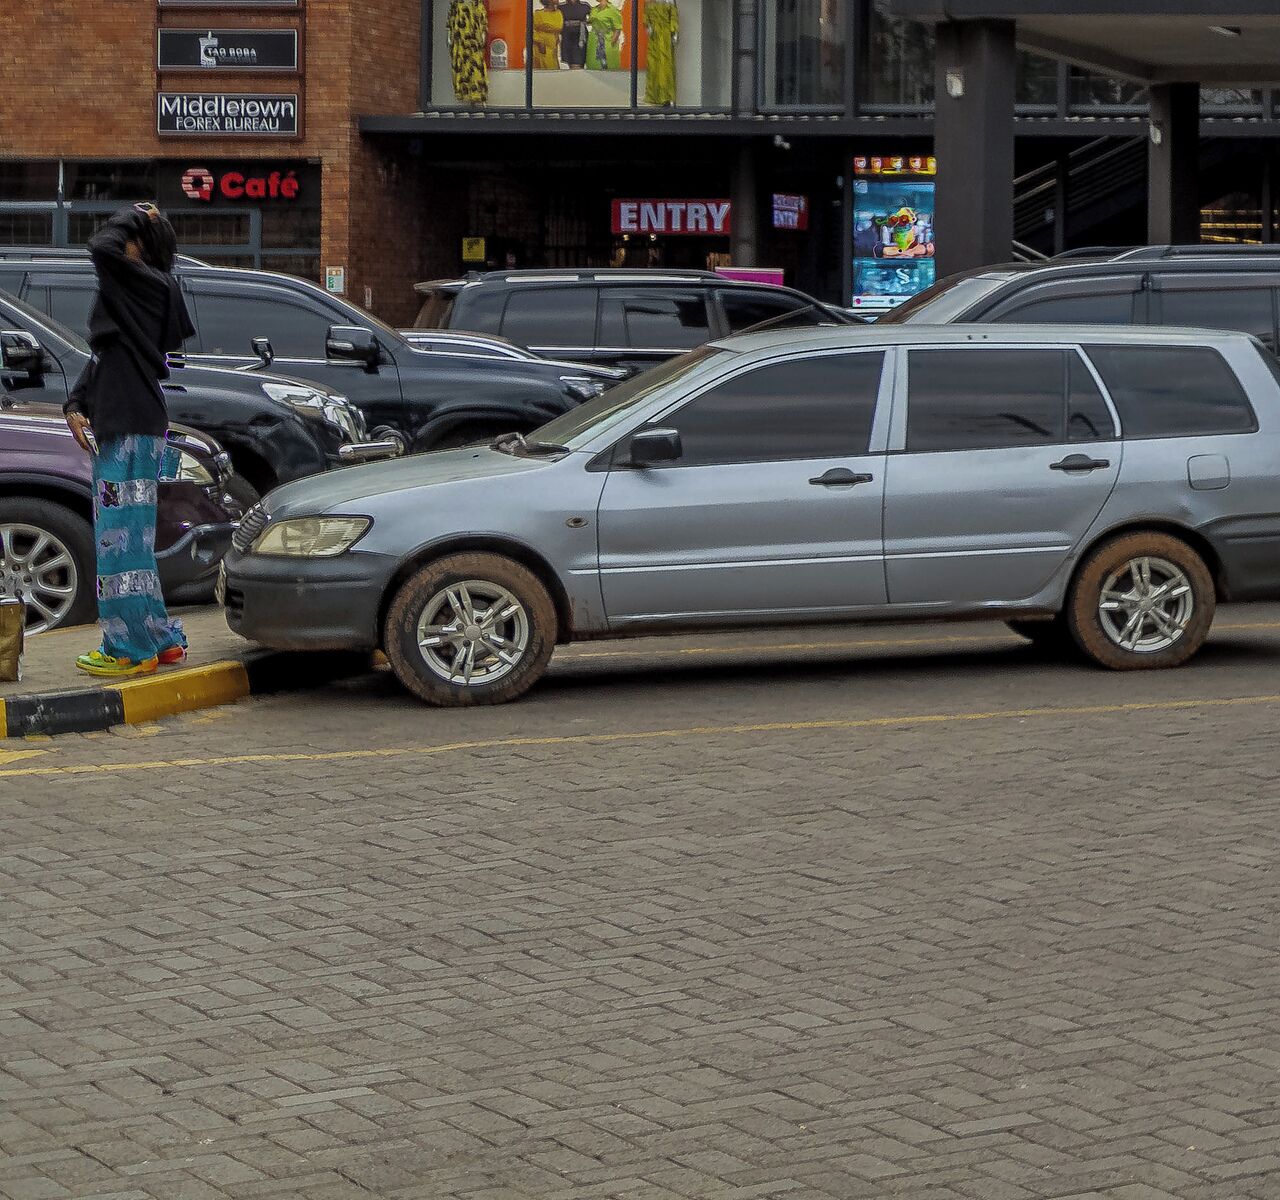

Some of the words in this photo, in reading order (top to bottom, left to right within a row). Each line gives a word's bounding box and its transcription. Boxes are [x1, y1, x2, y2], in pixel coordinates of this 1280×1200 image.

[161, 96, 294, 118] Middletown
[176, 117, 220, 131] FOREX
[225, 117, 279, 131] BUREAU
[221, 170, 299, 198] Café
[620, 203, 731, 232] ENTRY
